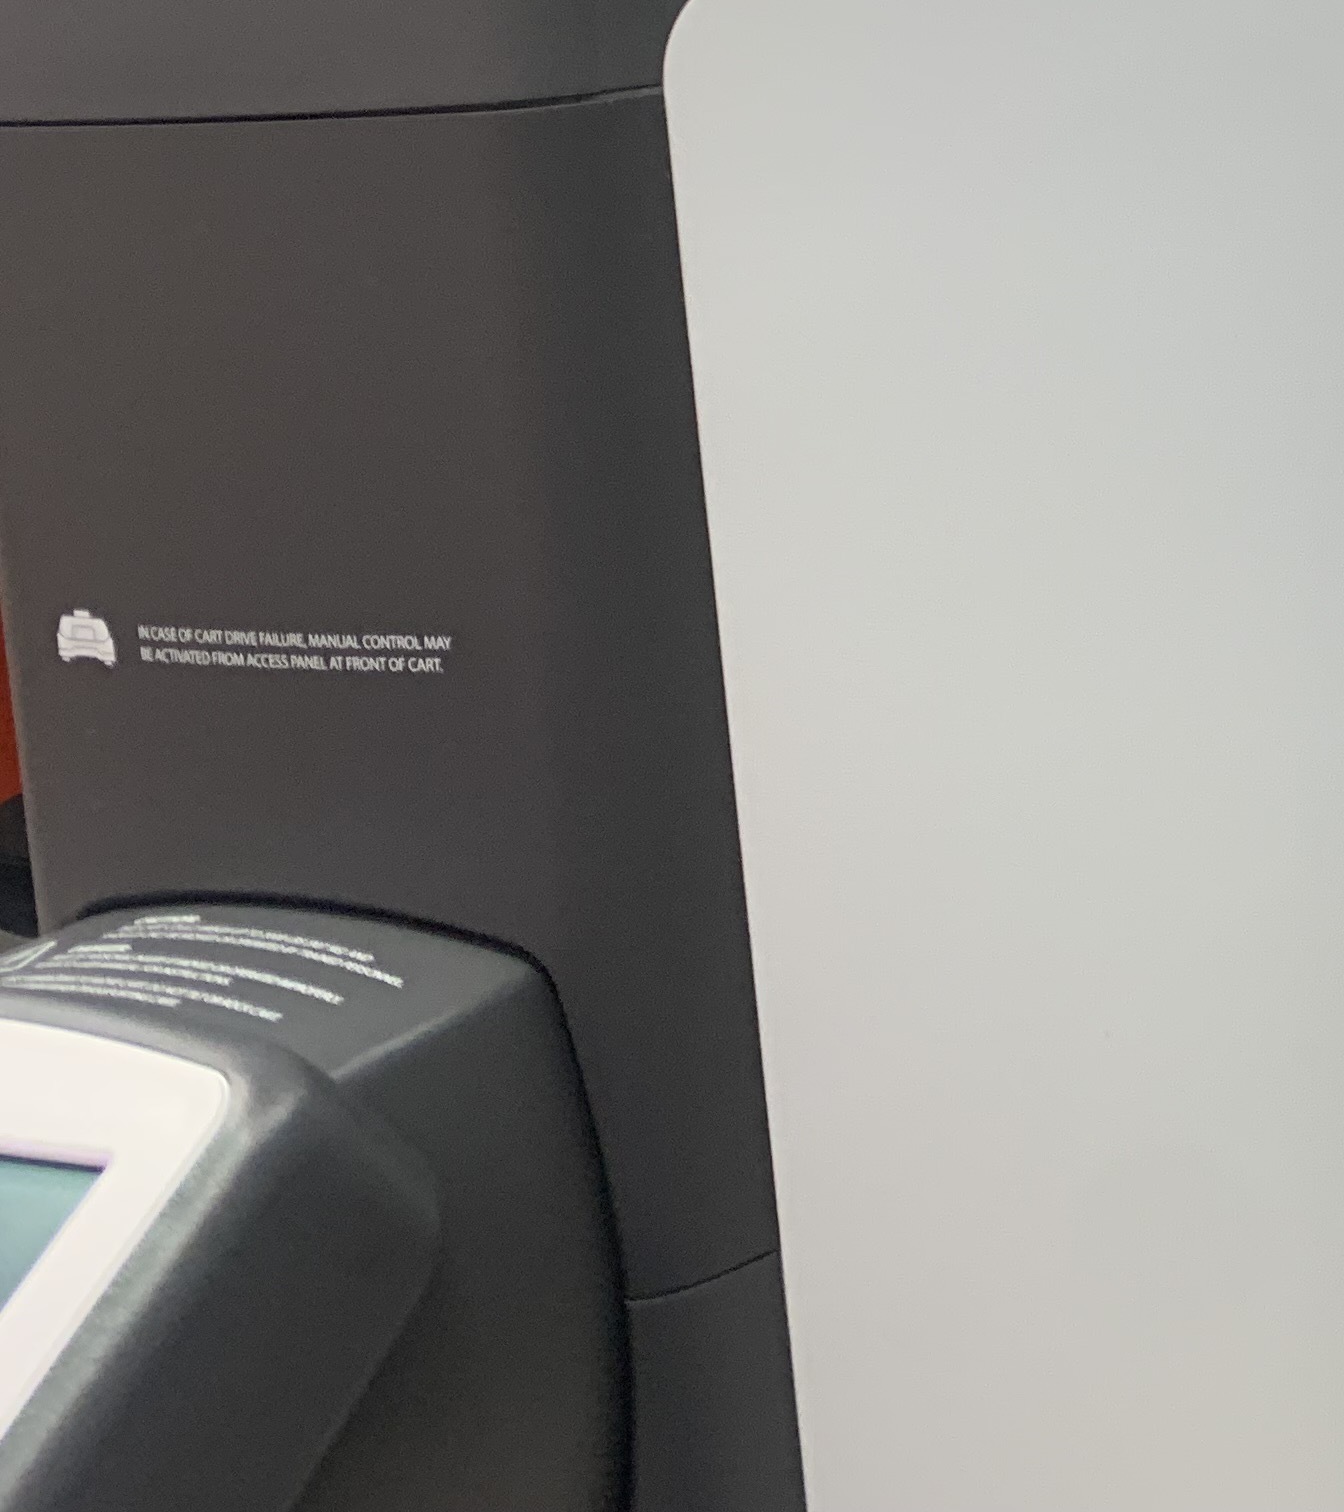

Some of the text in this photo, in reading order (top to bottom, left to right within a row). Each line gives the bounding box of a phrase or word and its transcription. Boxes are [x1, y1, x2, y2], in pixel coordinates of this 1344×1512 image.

[138, 624, 149, 639] IN
[150, 626, 177, 642] CASE
[178, 628, 193, 643] OF
[194, 628, 223, 644] CART
[225, 629, 257, 647] DRIVE
[308, 633, 361, 650] MANUAL
[362, 634, 422, 651] CONTROL
[423, 635, 452, 652] MAY
[141, 646, 444, 674] BE ACTIVATED FROM ACCESS PANEL AT FRONT OF CART.
